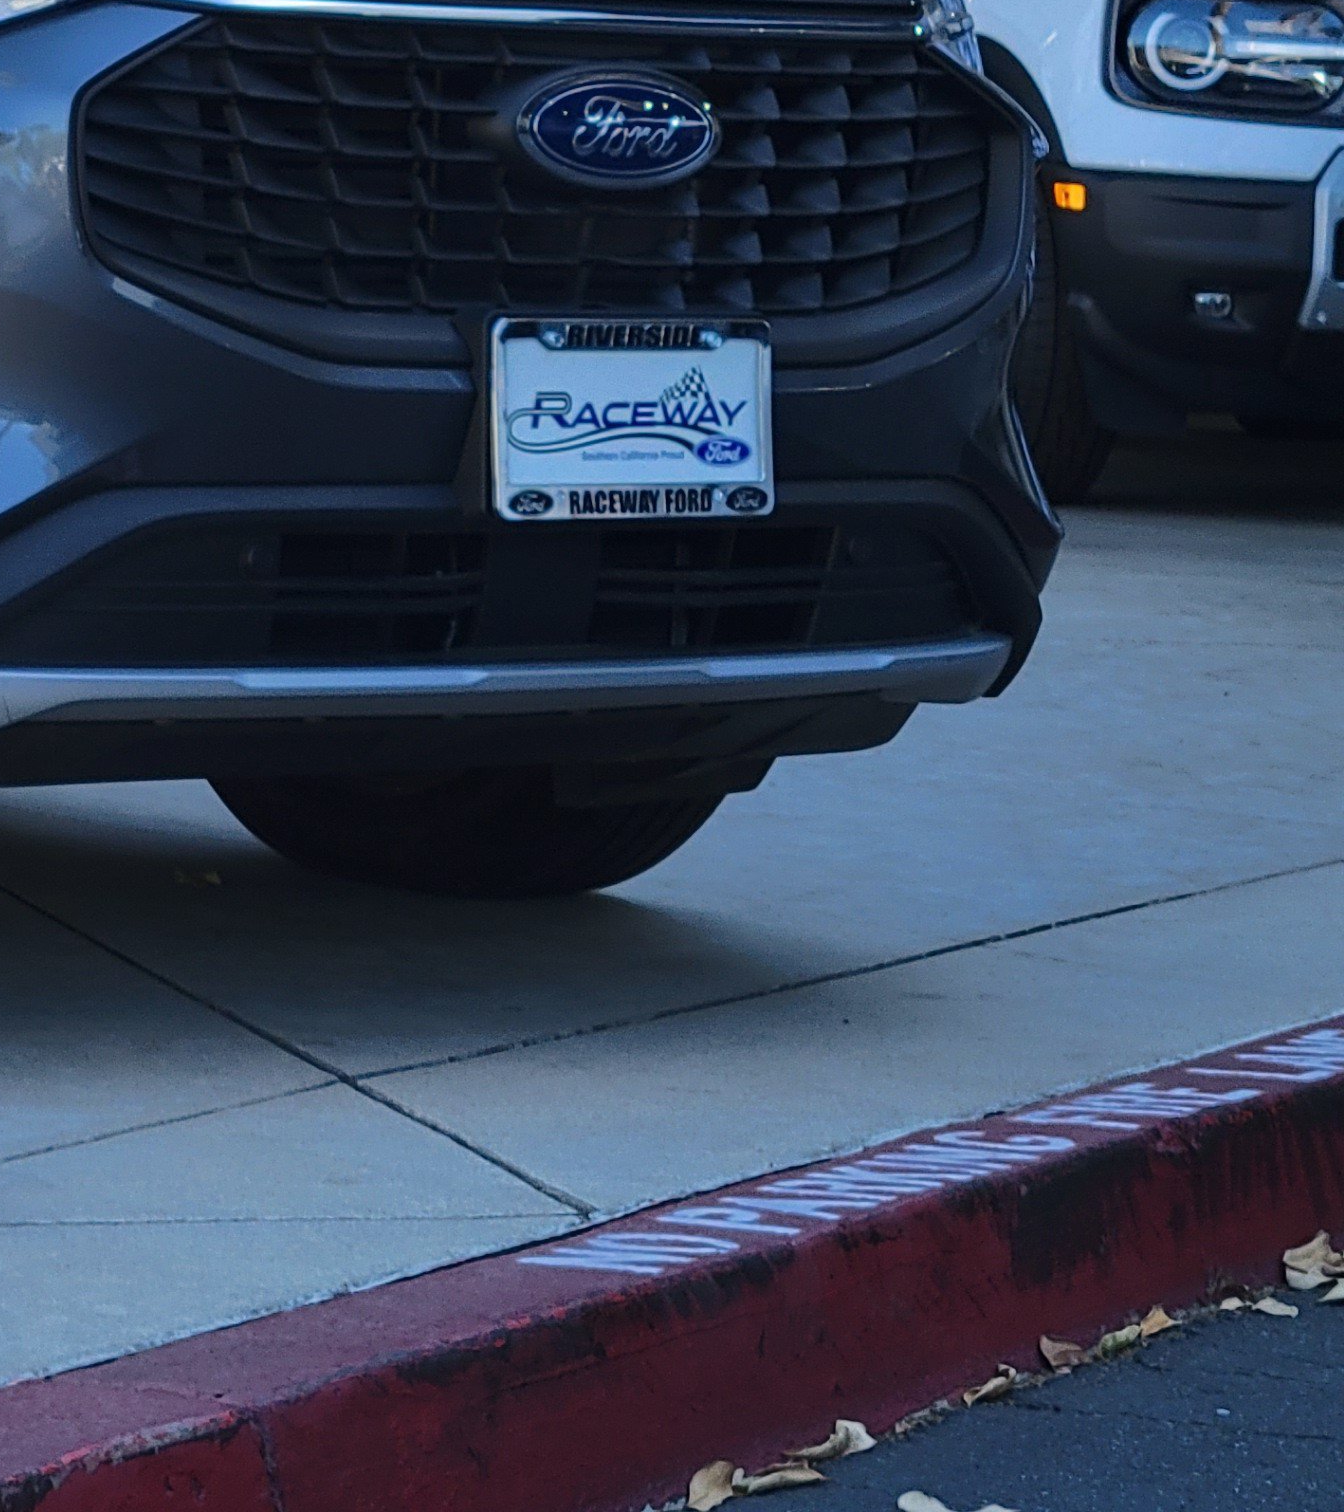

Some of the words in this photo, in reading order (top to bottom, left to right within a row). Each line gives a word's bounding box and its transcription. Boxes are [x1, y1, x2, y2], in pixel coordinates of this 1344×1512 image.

[571, 95, 678, 158] Ford
[529, 391, 747, 430] RACEWAY
[703, 440, 743, 463] Ford
[569, 489, 660, 515] RACEWAY
[664, 488, 713, 514] FORD
[515, 1232, 741, 1275] NO
[655, 1129, 1078, 1235] PARKING
[1010, 1081, 1263, 1129] FIRE
